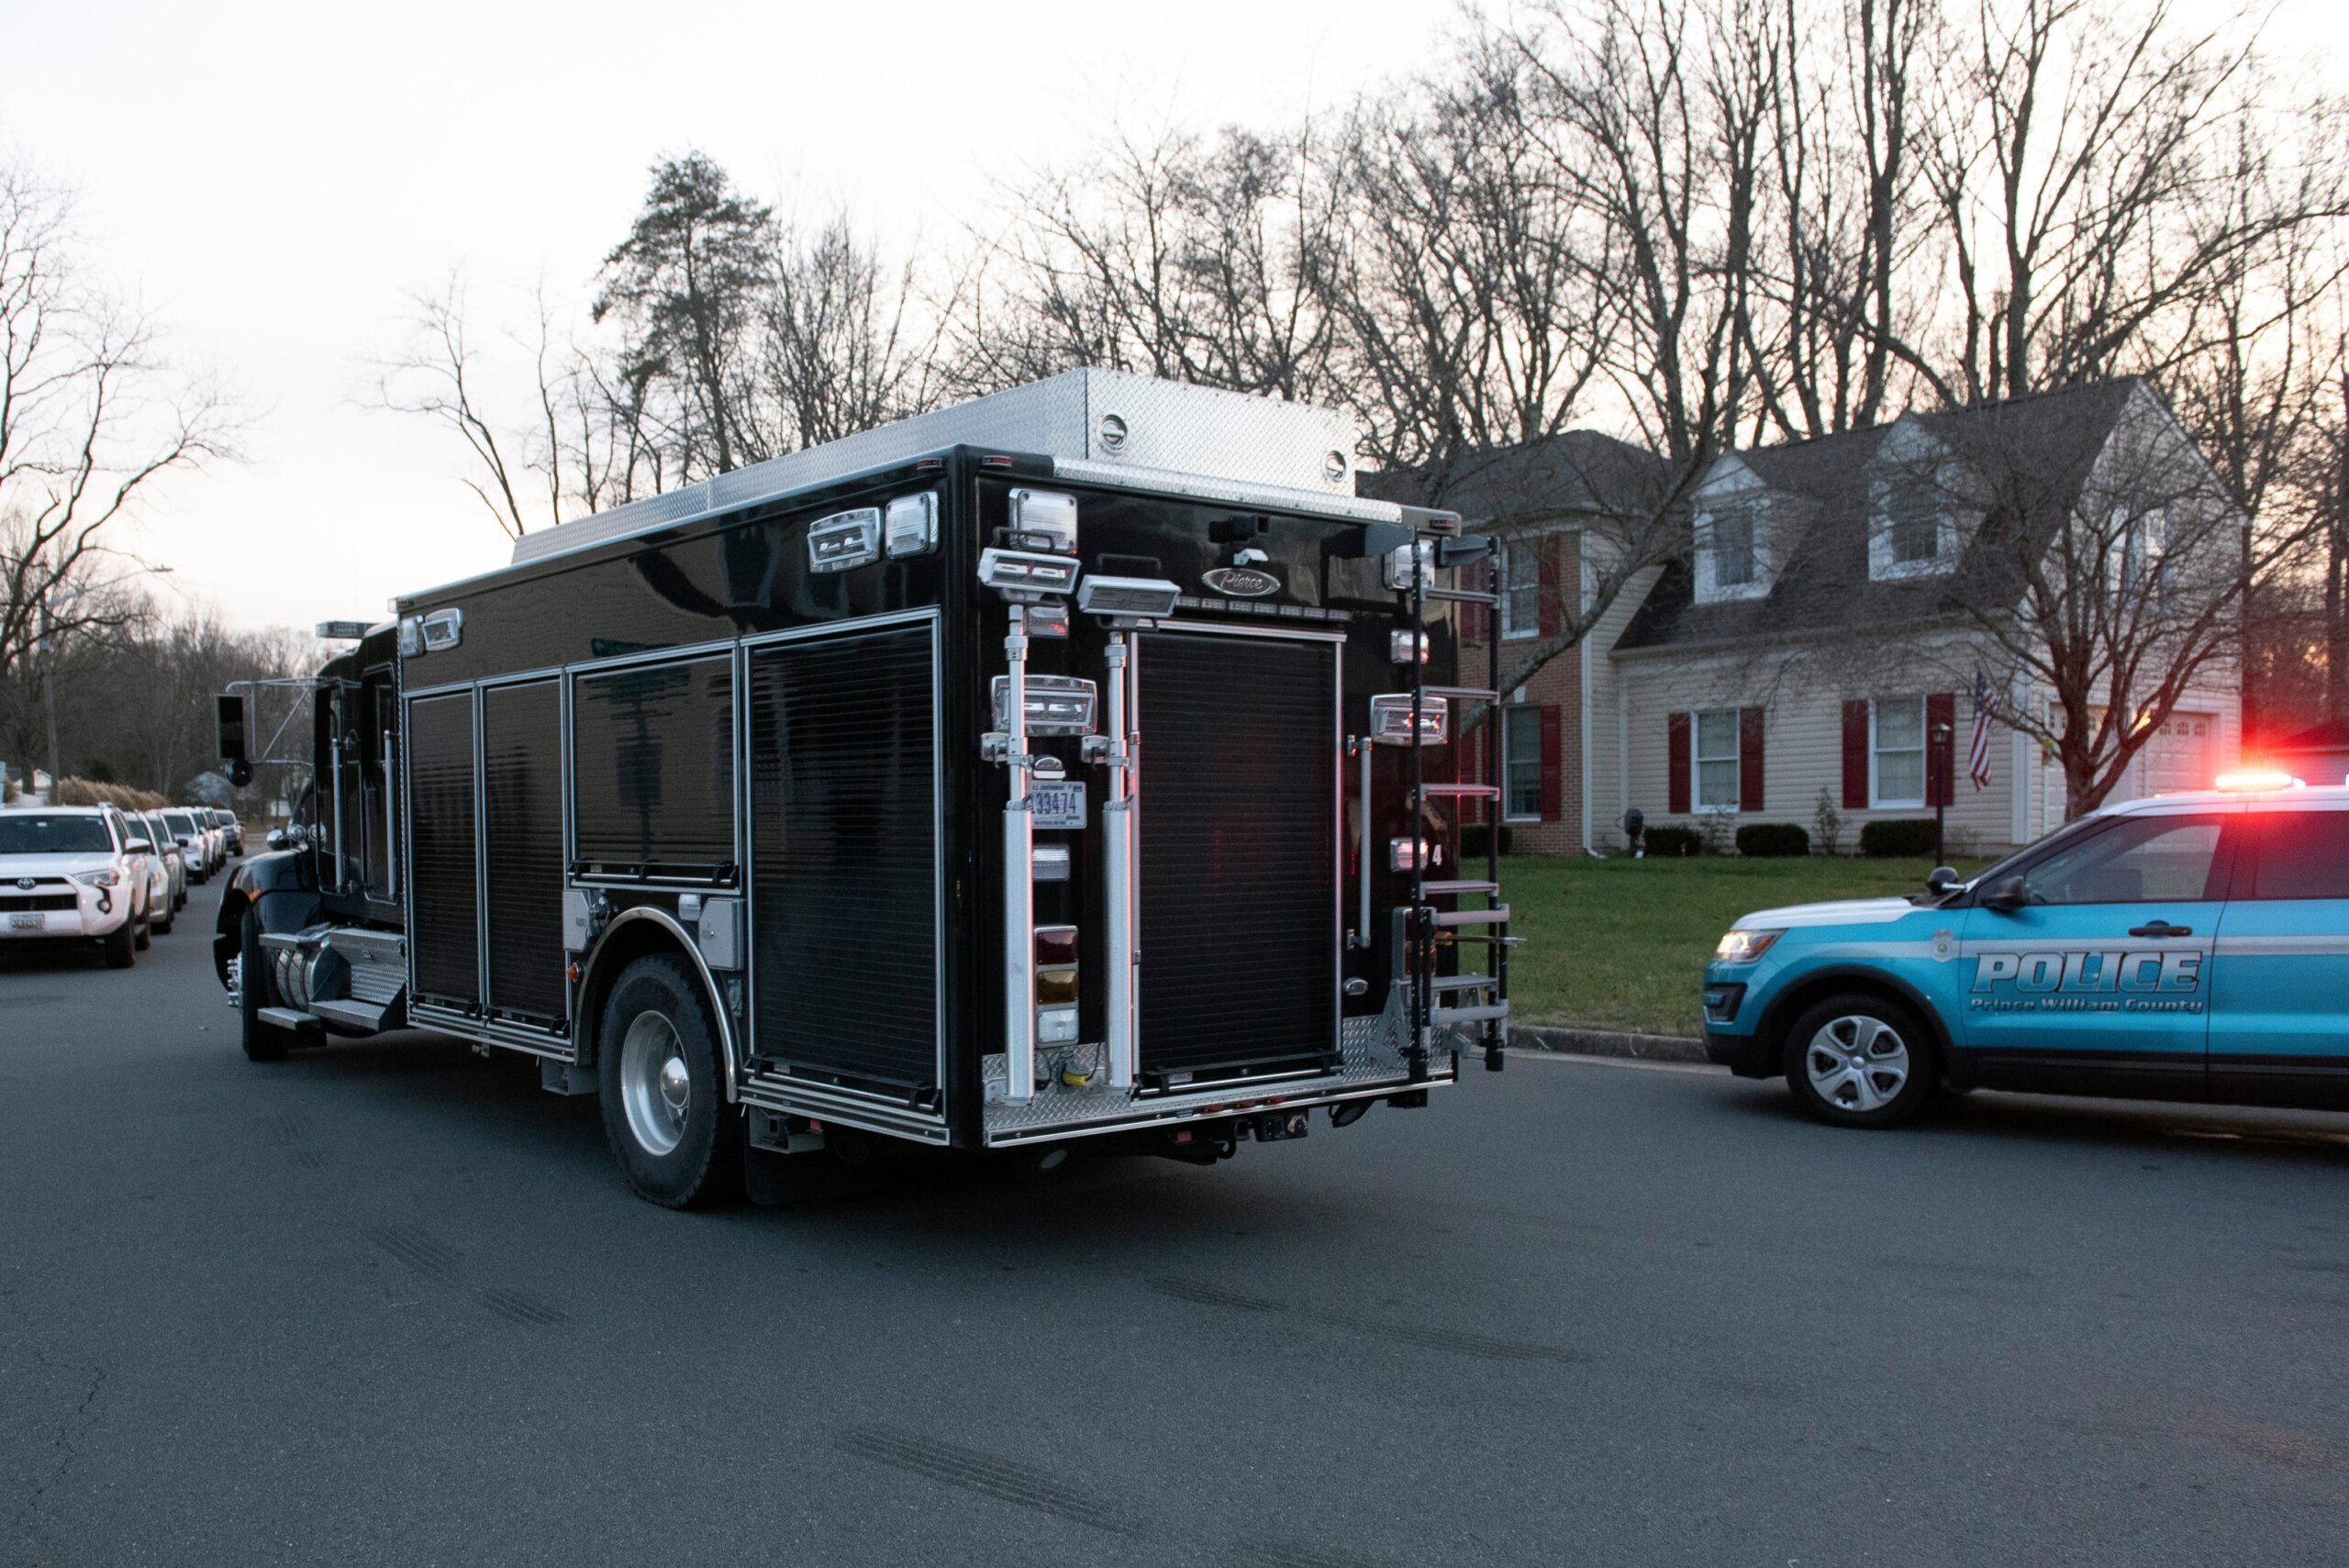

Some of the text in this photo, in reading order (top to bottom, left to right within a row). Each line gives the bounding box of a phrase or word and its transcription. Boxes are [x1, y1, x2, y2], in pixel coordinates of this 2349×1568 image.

[1220, 571, 1264, 590] Pierce
[1432, 844, 1442, 866] 4
[1969, 951, 2203, 994] POLICE
[1970, 997, 2203, 1015] Prince William County
